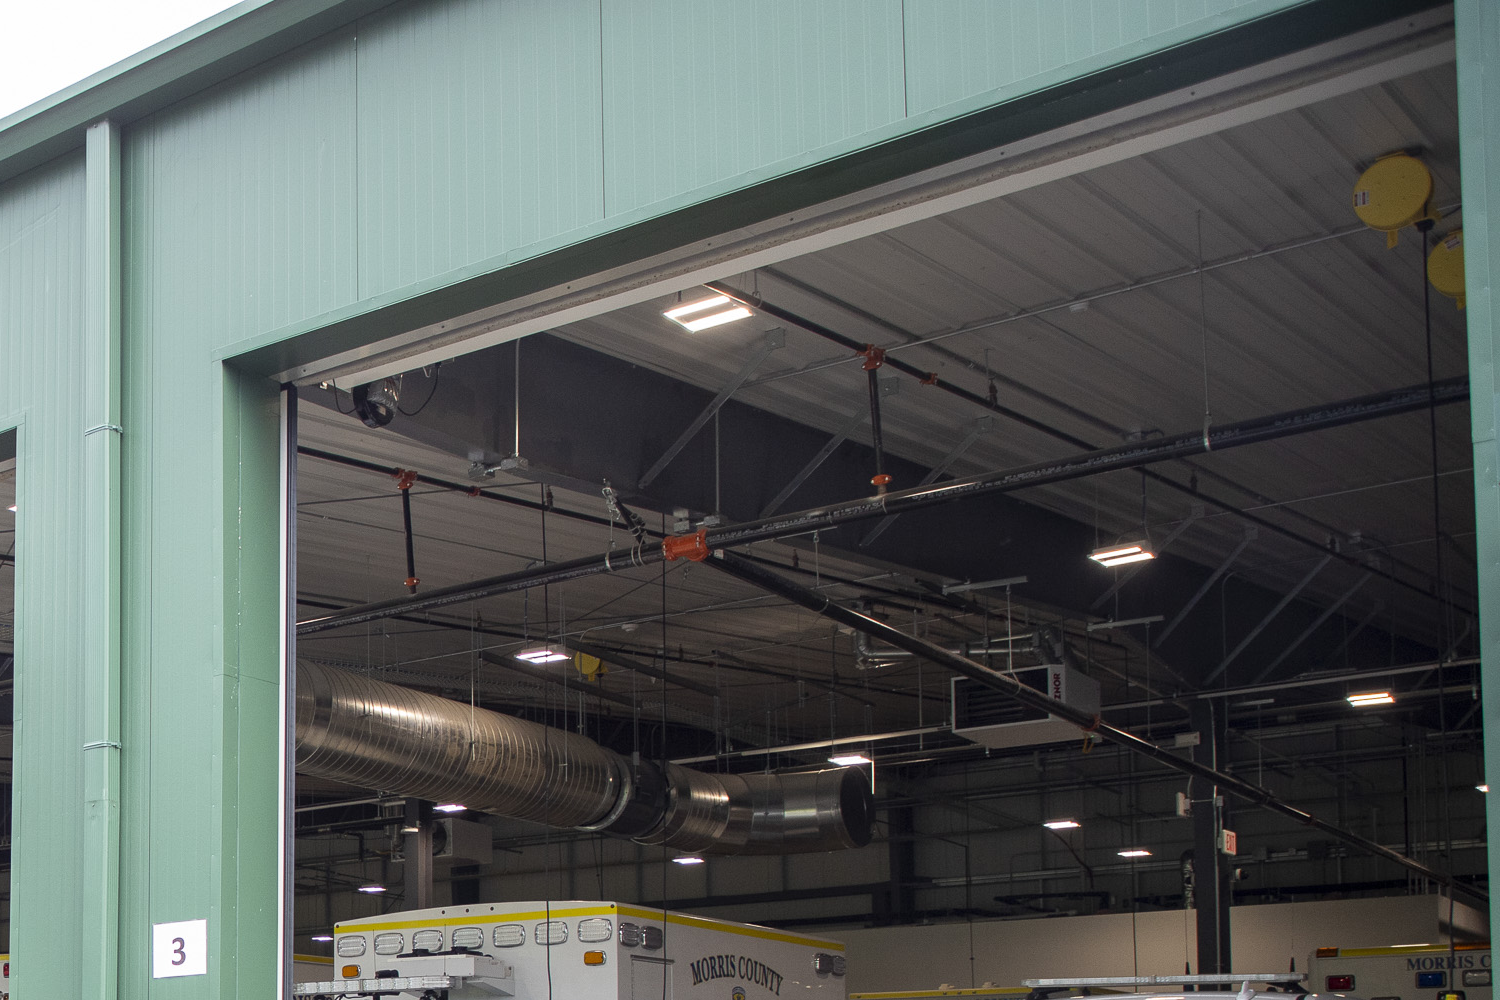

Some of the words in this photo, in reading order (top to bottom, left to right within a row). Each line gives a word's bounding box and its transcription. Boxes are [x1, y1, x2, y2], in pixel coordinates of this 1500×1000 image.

[1053, 673, 1062, 700] ZNOR
[172, 937, 186, 966] 3
[1405, 955, 1474, 972] MORRIS
[690, 954, 736, 986] MORRIS
[738, 955, 784, 996] COUNTY
